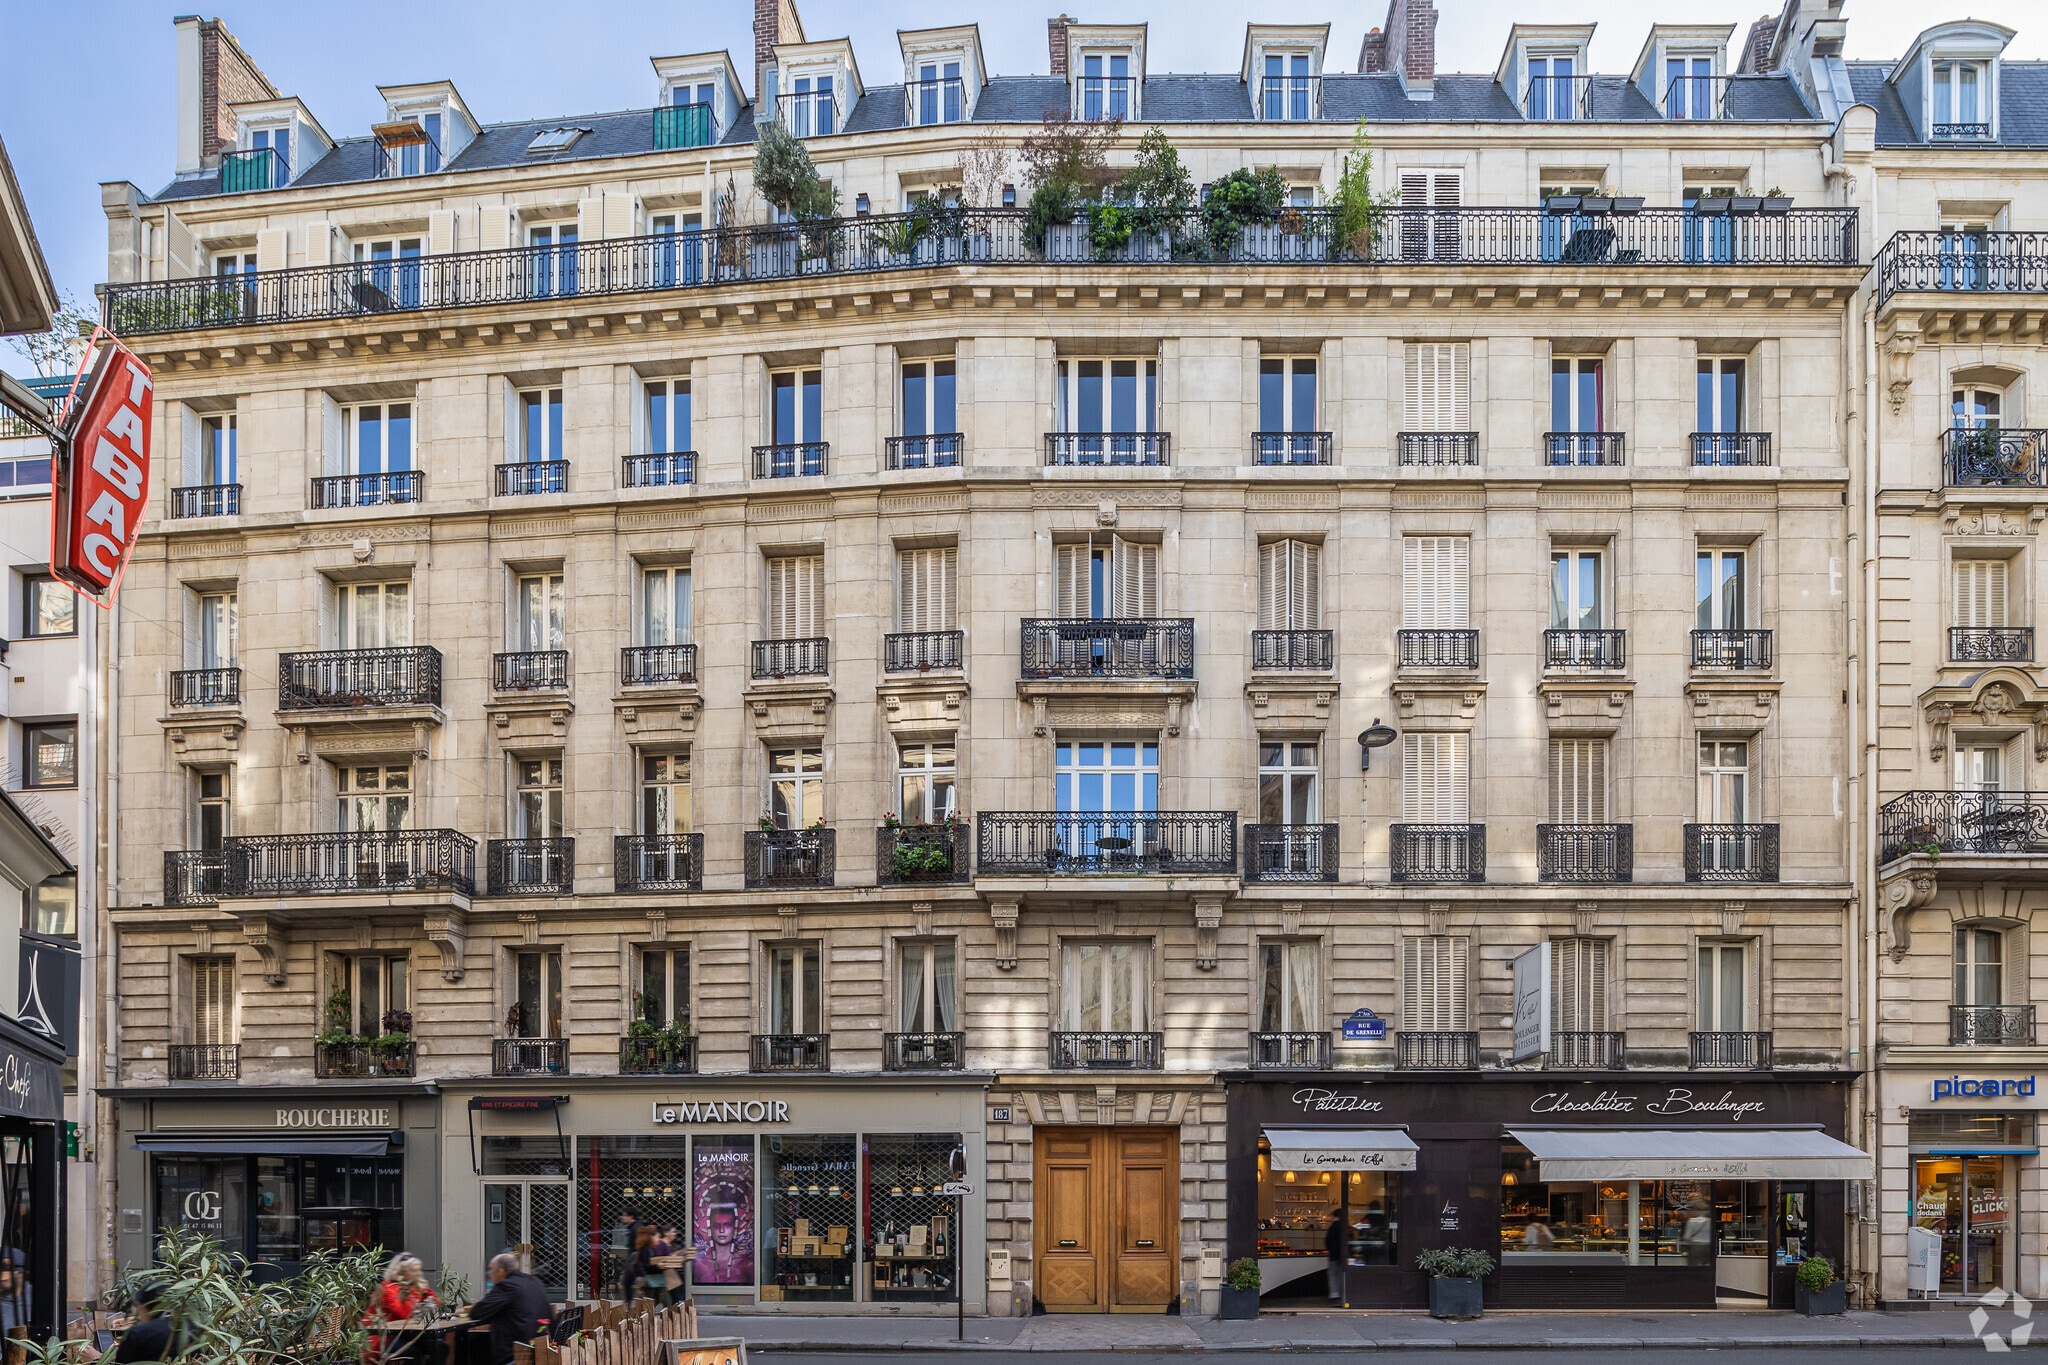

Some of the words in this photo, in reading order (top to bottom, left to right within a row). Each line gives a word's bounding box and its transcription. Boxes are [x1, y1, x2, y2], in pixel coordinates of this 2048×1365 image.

[83, 361, 153, 578] TABAC
[1514, 1023, 1539, 1040] BOULANGER
[1931, 1075, 2035, 1101] picard
[1292, 1088, 1383, 1112] Pâtissier
[1530, 1091, 1638, 1113] Chocolatier
[1646, 1088, 1766, 1121] Boulanger
[275, 1108, 390, 1127] BOUCHERIE
[652, 1101, 676, 1123] Le
[680, 1100, 790, 1123] MANOIR
[995, 1109, 1008, 1119] 187
[698, 1153, 707, 1162] Le
[710, 1153, 749, 1162] MANOIR
[1916, 1209, 1946, 1217] dedans!
[1917, 1202, 1946, 1210] Chaud
[1971, 1201, 2004, 1215] CLICK
